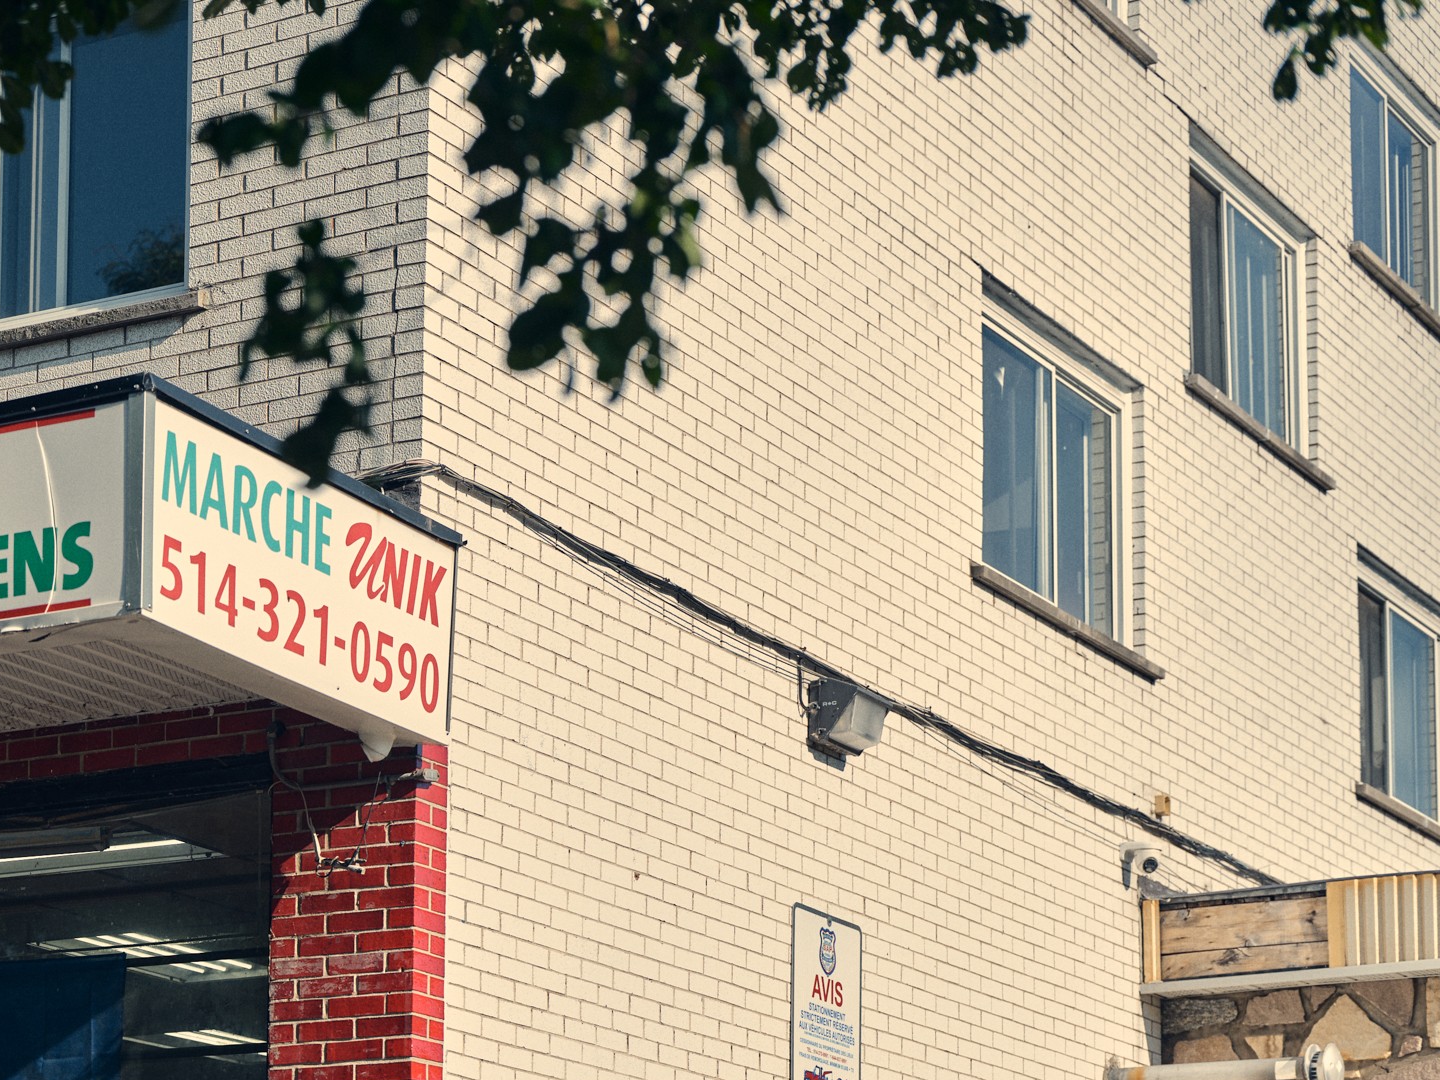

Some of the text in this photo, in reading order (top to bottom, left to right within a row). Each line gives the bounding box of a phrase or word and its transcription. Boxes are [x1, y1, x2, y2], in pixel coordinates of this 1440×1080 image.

[161, 430, 448, 628] MARCHE UNIK
[159, 533, 441, 714] 514-321-0590
[812, 974, 843, 1007] AVIS
[800, 1009, 832, 1028] STRICTEMENT
[808, 1002, 846, 1022] STATIONNEMENT
[799, 1021, 808, 1031] AUX
